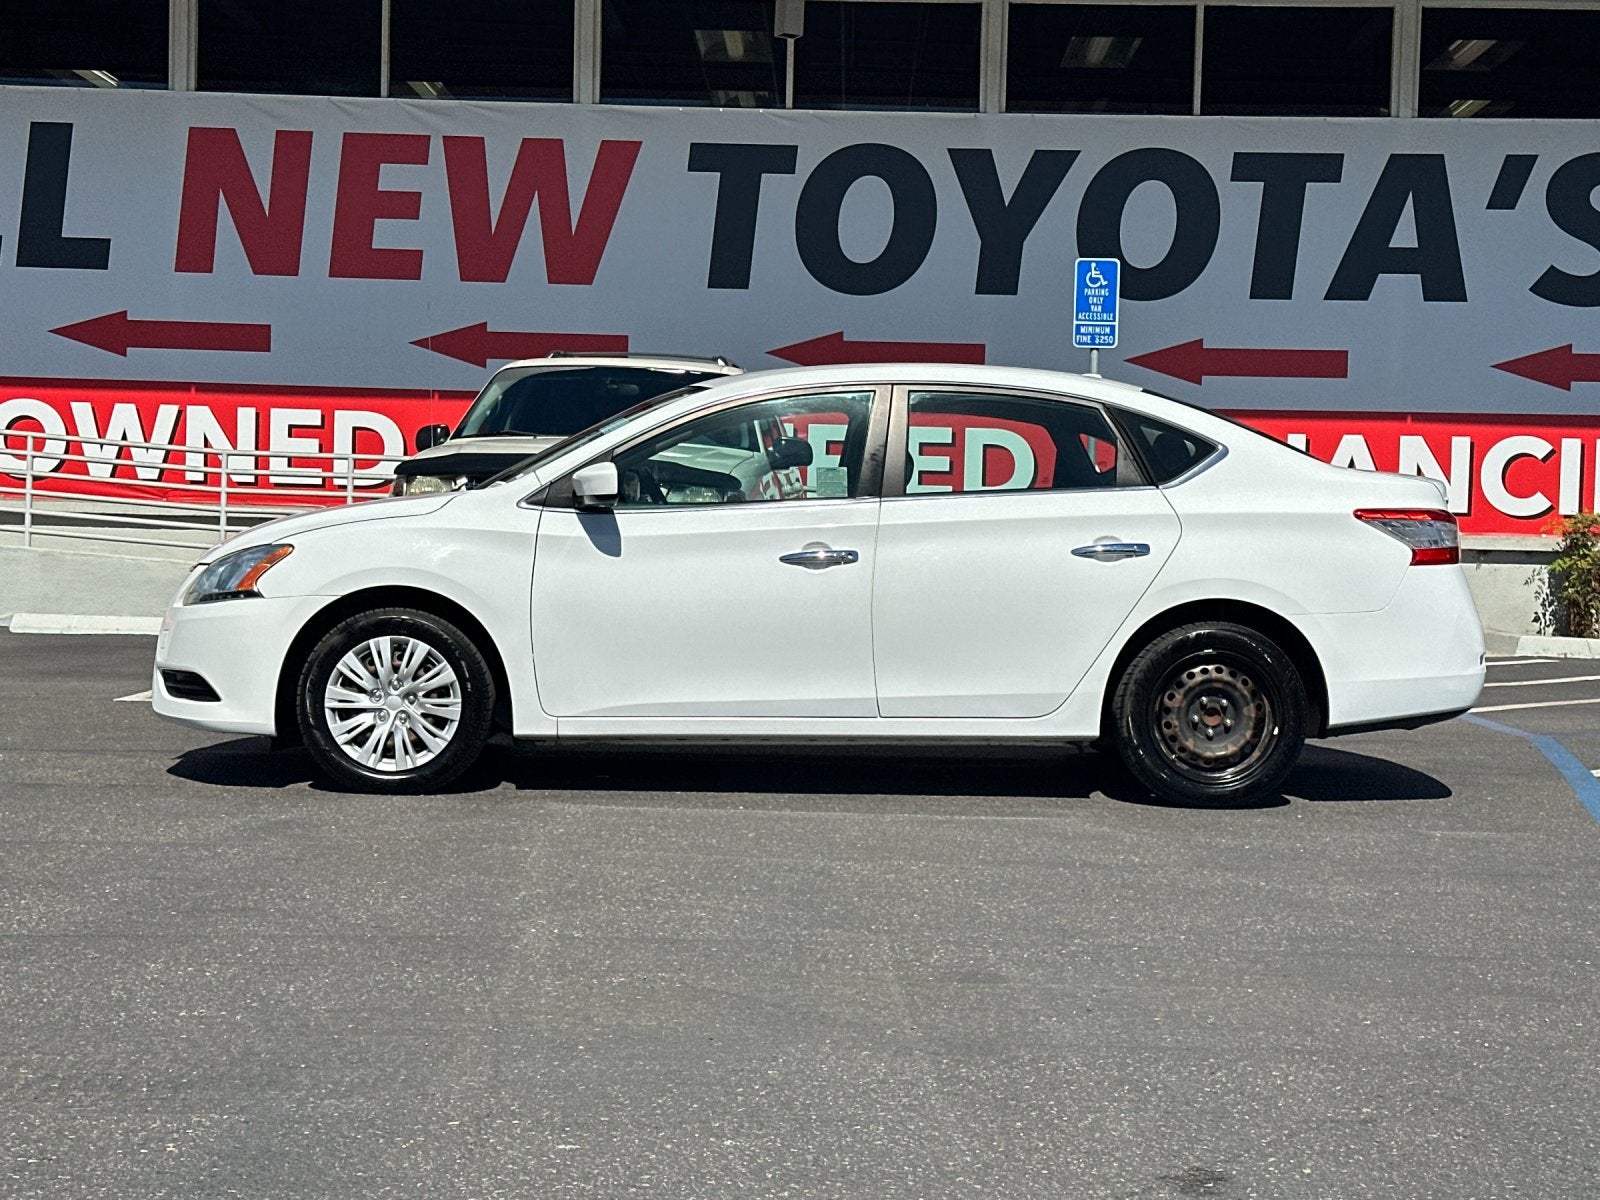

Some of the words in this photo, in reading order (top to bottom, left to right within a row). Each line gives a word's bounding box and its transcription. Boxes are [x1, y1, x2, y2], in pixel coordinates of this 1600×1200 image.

[0, 121, 111, 270] L
[174, 127, 642, 285] NEW
[688, 142, 1600, 308] TOYOTA'S
[1084, 288, 1109, 296] PARKING
[1078, 312, 1114, 321] ACCESSIBLE
[1080, 325, 1110, 334] MINIMUM
[1076, 335, 1092, 343] FINE
[1094, 335, 1114, 344] $250
[0, 397, 404, 486] OWNED
